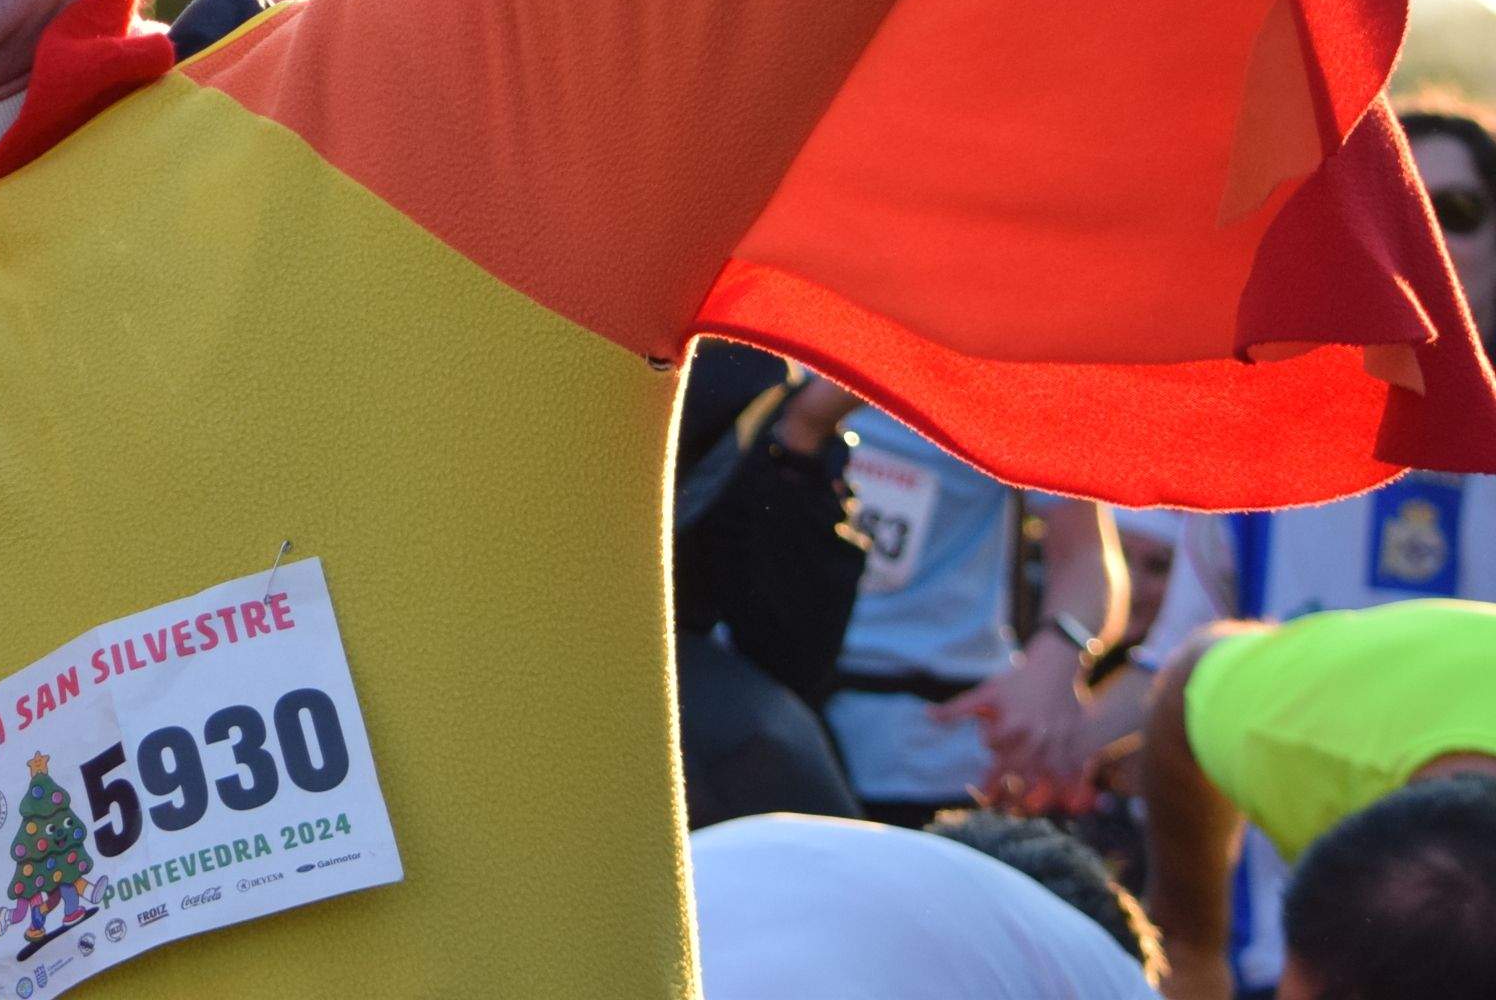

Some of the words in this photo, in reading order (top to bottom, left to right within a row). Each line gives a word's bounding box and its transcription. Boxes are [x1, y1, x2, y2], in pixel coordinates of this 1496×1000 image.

[15, 666, 80, 731] SAN
[90, 592, 295, 685] SILVESTRE
[78, 687, 350, 859] 5930
[103, 833, 273, 910] PONTEVEDRA
[280, 812, 352, 850] 2024
[316, 851, 361, 869] Galmotor
[136, 903, 168, 924] FROIZ
